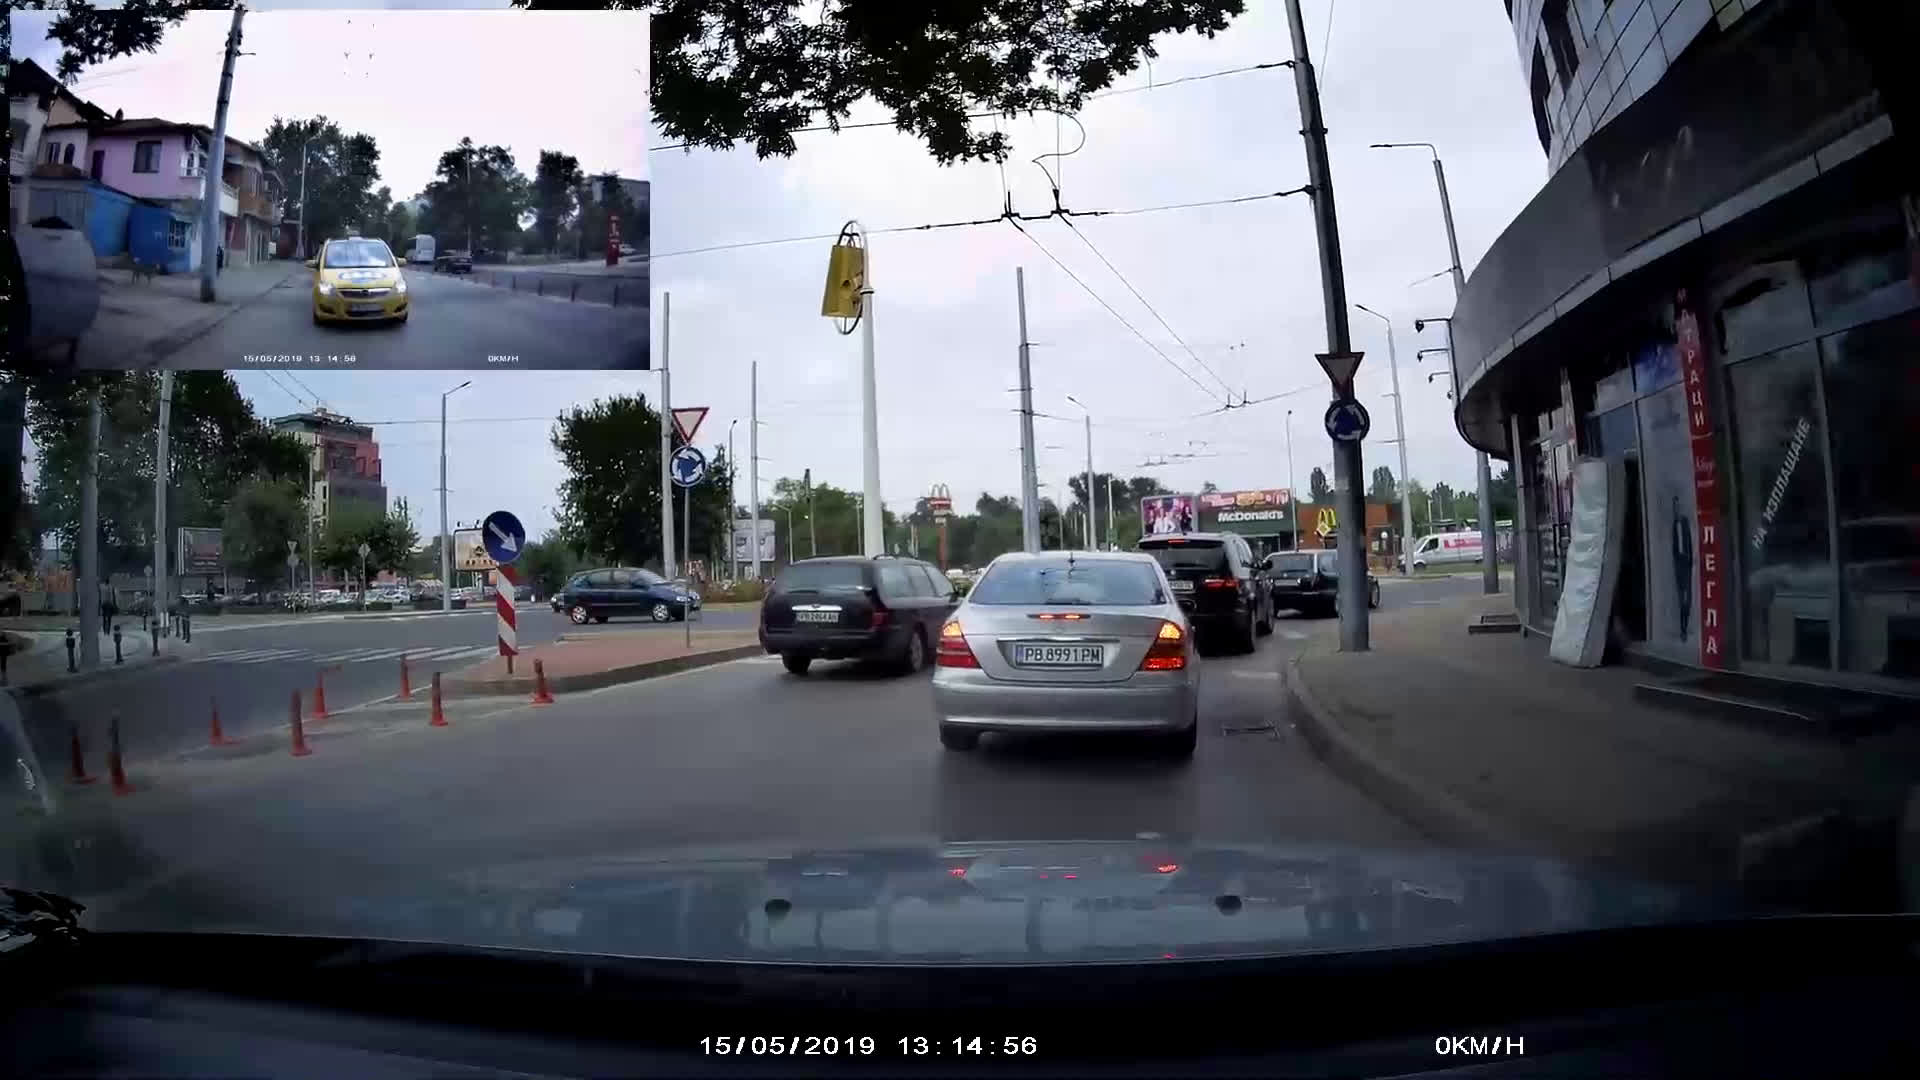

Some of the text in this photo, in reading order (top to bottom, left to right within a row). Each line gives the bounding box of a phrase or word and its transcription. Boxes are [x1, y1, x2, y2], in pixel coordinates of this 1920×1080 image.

[1218, 510, 1284, 522] McDonald's
[1763, 417, 1811, 522] ИЗПЛАЩАНЕ
[1703, 526, 1718, 654] ЛЕГЛА
